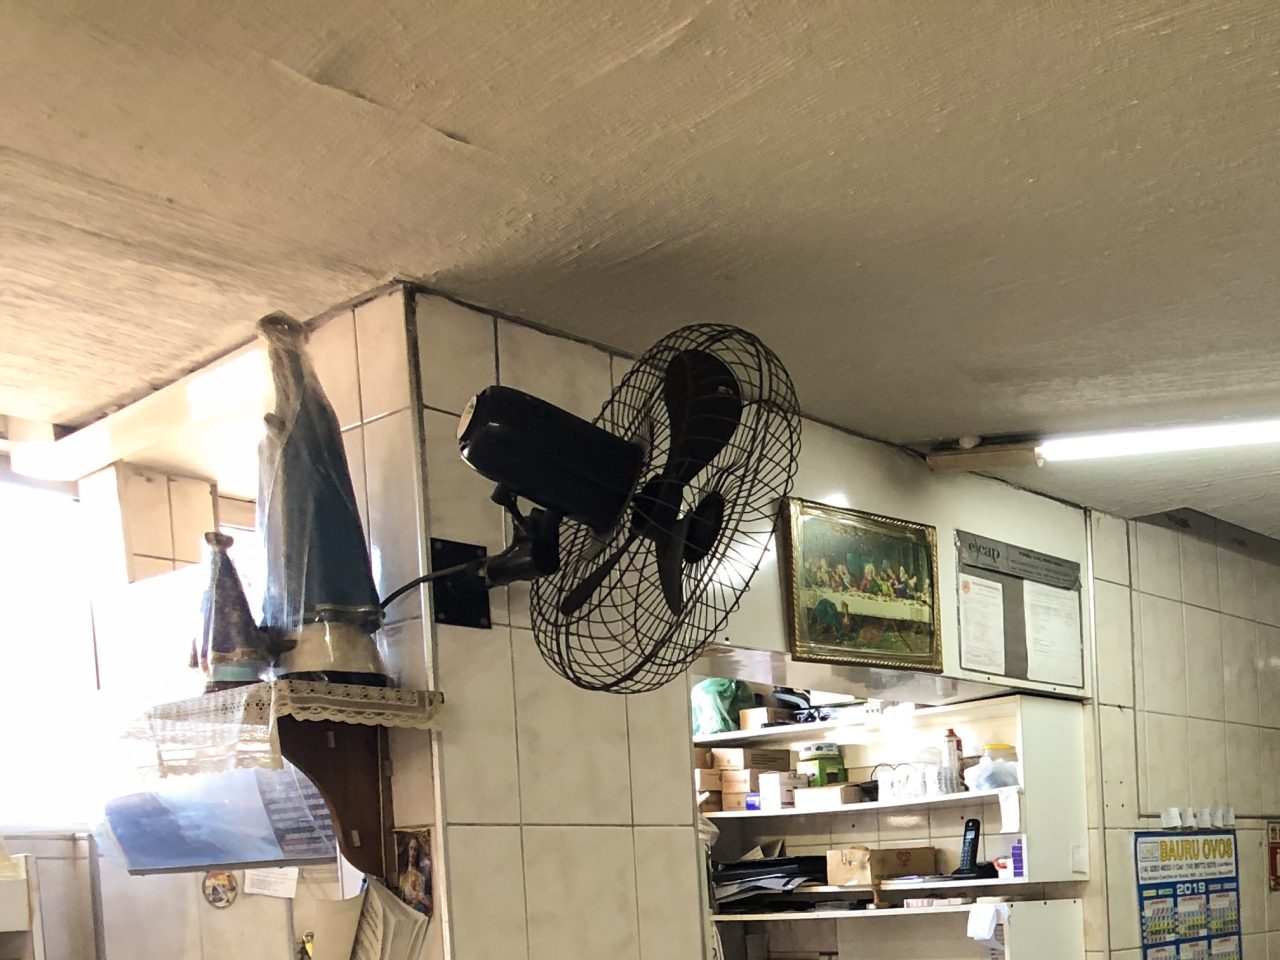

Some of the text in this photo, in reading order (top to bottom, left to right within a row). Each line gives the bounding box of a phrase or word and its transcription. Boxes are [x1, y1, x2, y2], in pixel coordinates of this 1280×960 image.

[1160, 838, 1233, 862] BAURU OVOS
[1176, 882, 1206, 896] 2019
